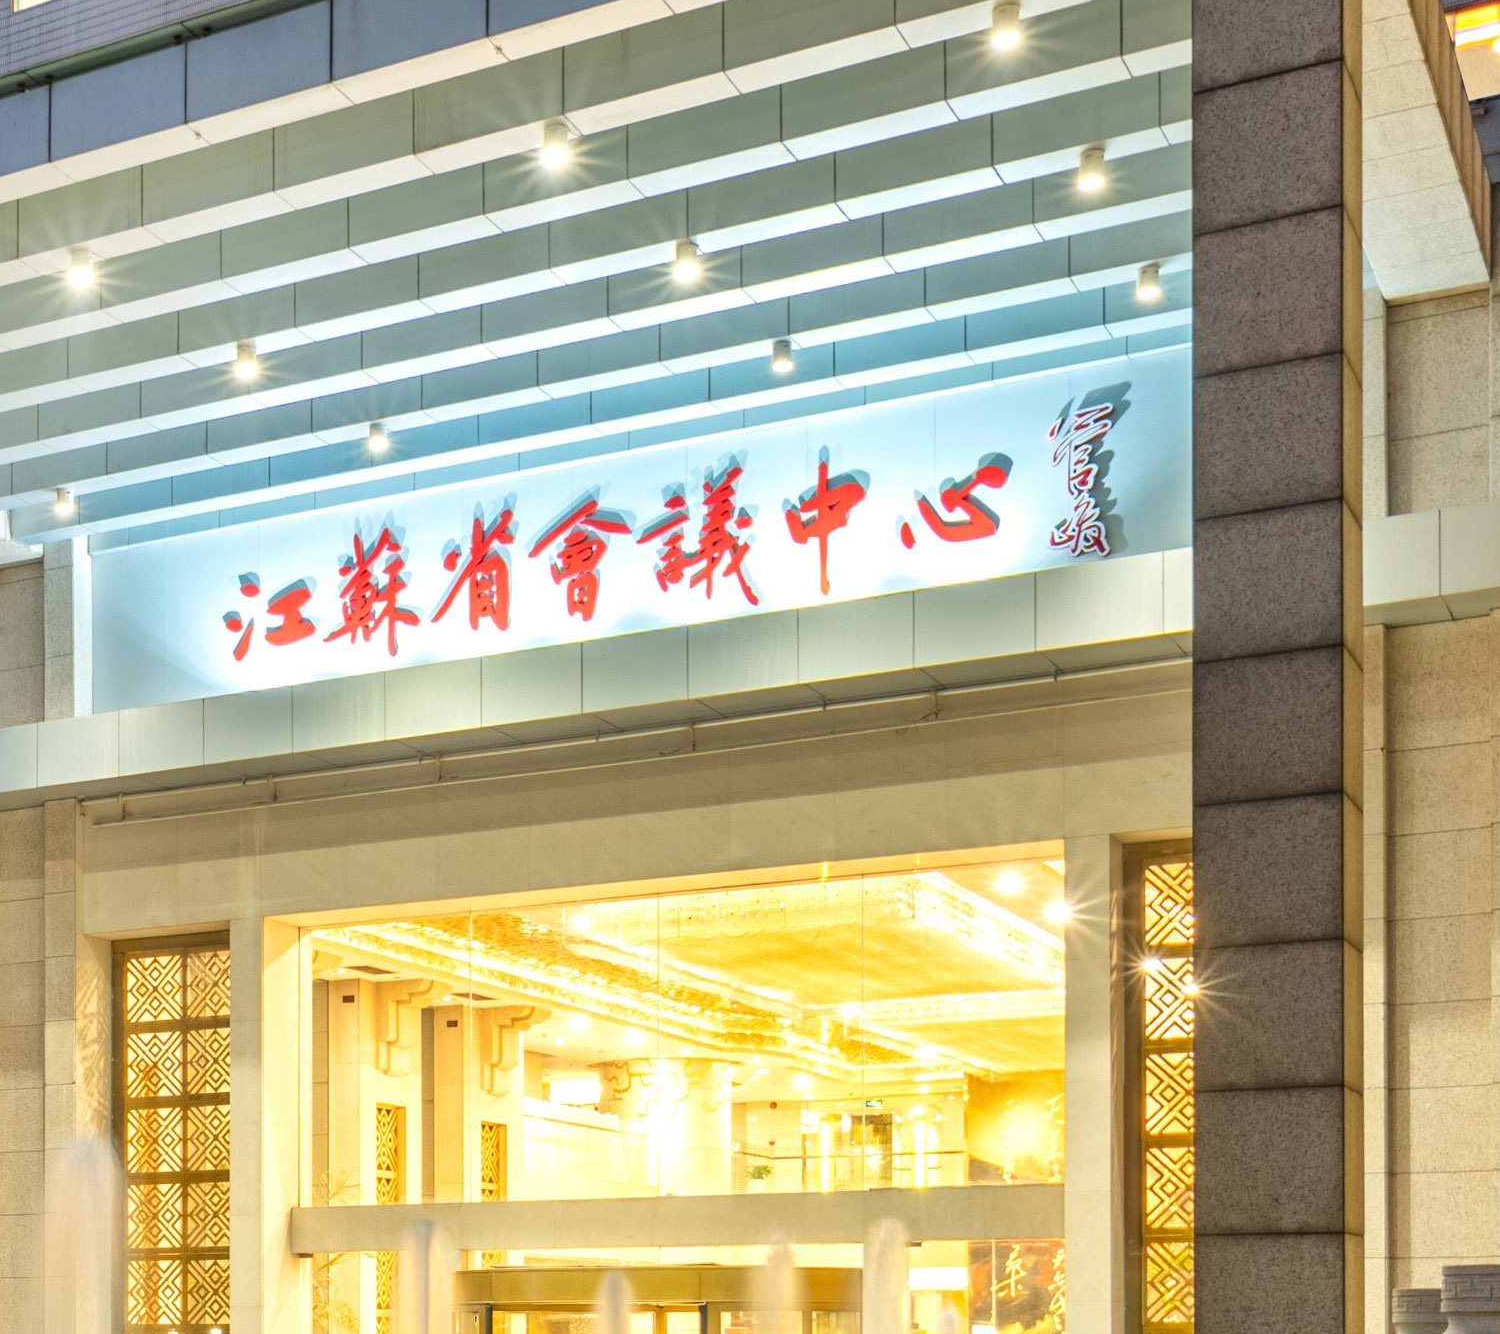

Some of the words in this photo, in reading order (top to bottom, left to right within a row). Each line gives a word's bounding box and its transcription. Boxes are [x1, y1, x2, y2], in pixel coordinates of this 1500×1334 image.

[224, 453, 1010, 661] 江蘇省會議中心
